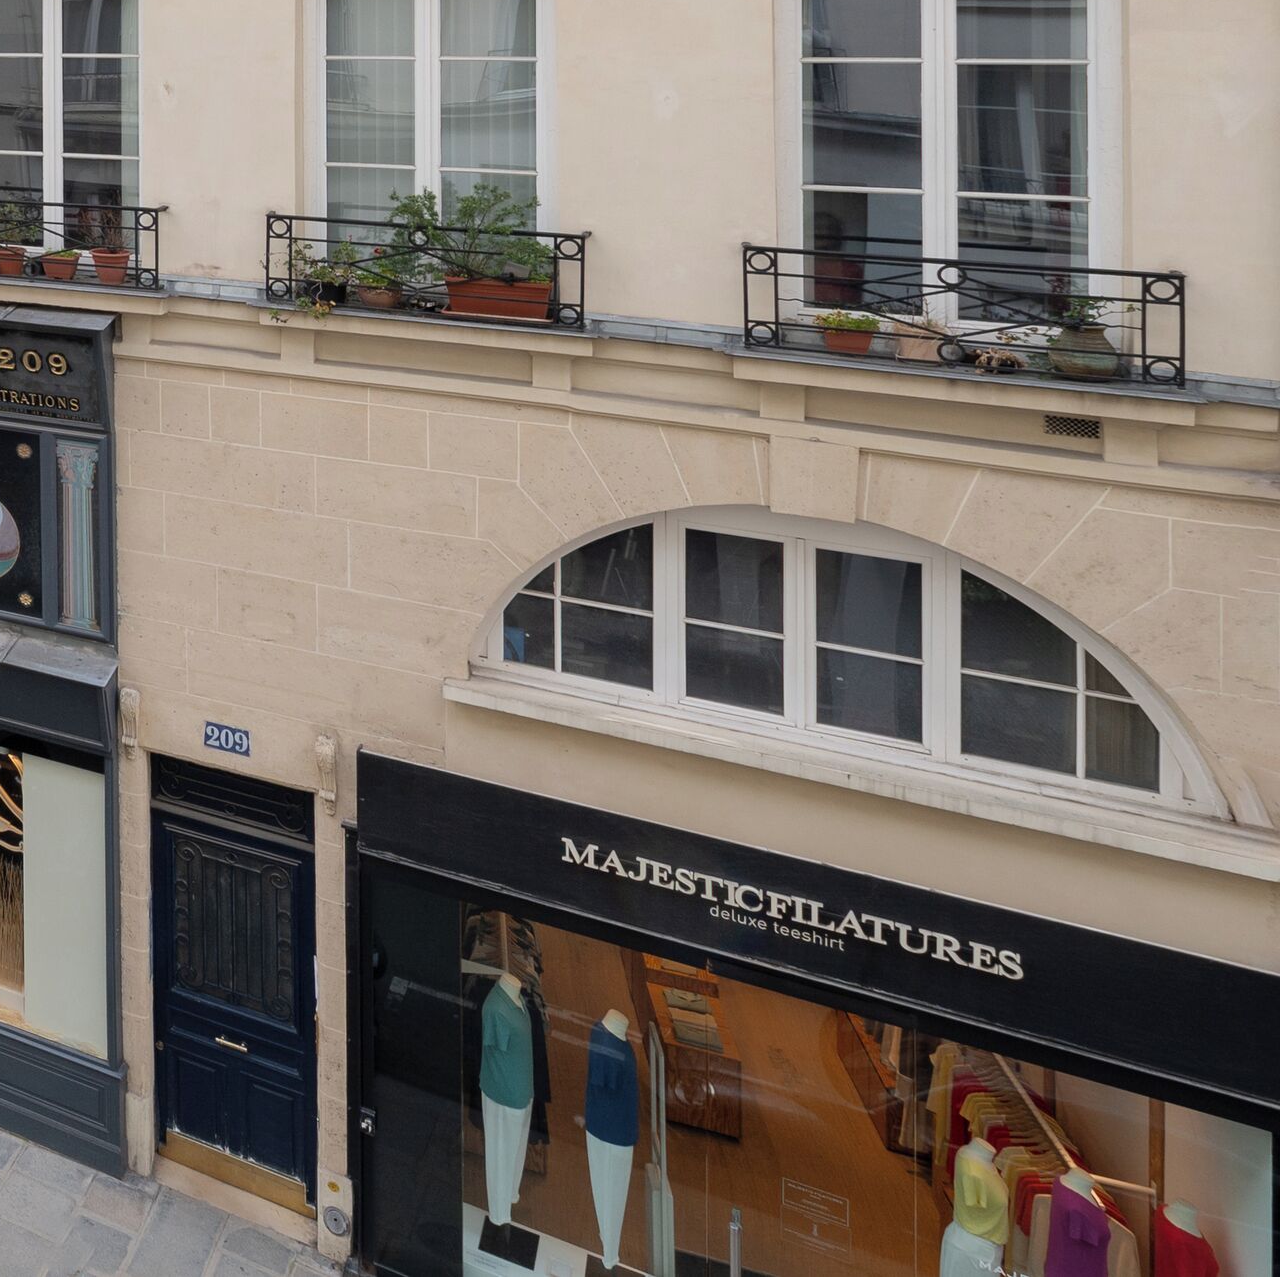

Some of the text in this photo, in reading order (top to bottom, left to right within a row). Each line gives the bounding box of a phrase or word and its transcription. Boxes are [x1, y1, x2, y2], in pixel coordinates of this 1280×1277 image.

[206, 725, 249, 753] 209
[709, 903, 845, 953] deluxe teeshirt
